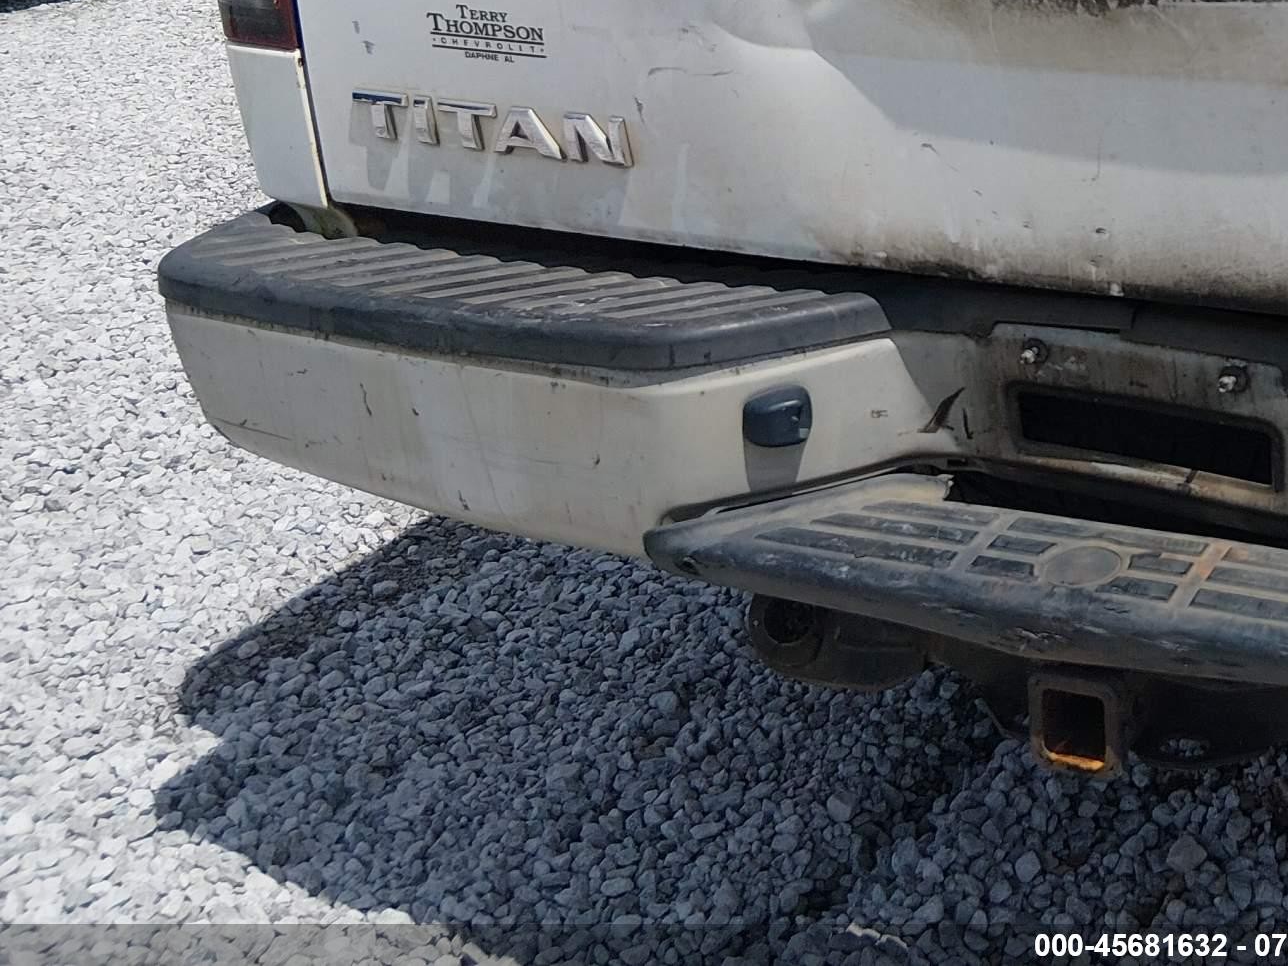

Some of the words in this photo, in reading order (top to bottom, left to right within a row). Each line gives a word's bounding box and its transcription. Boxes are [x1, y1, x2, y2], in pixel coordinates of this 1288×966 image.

[464, 51, 500, 62] DAPHNE
[504, 54, 515, 64] AL
[352, 88, 634, 168] TITAN
